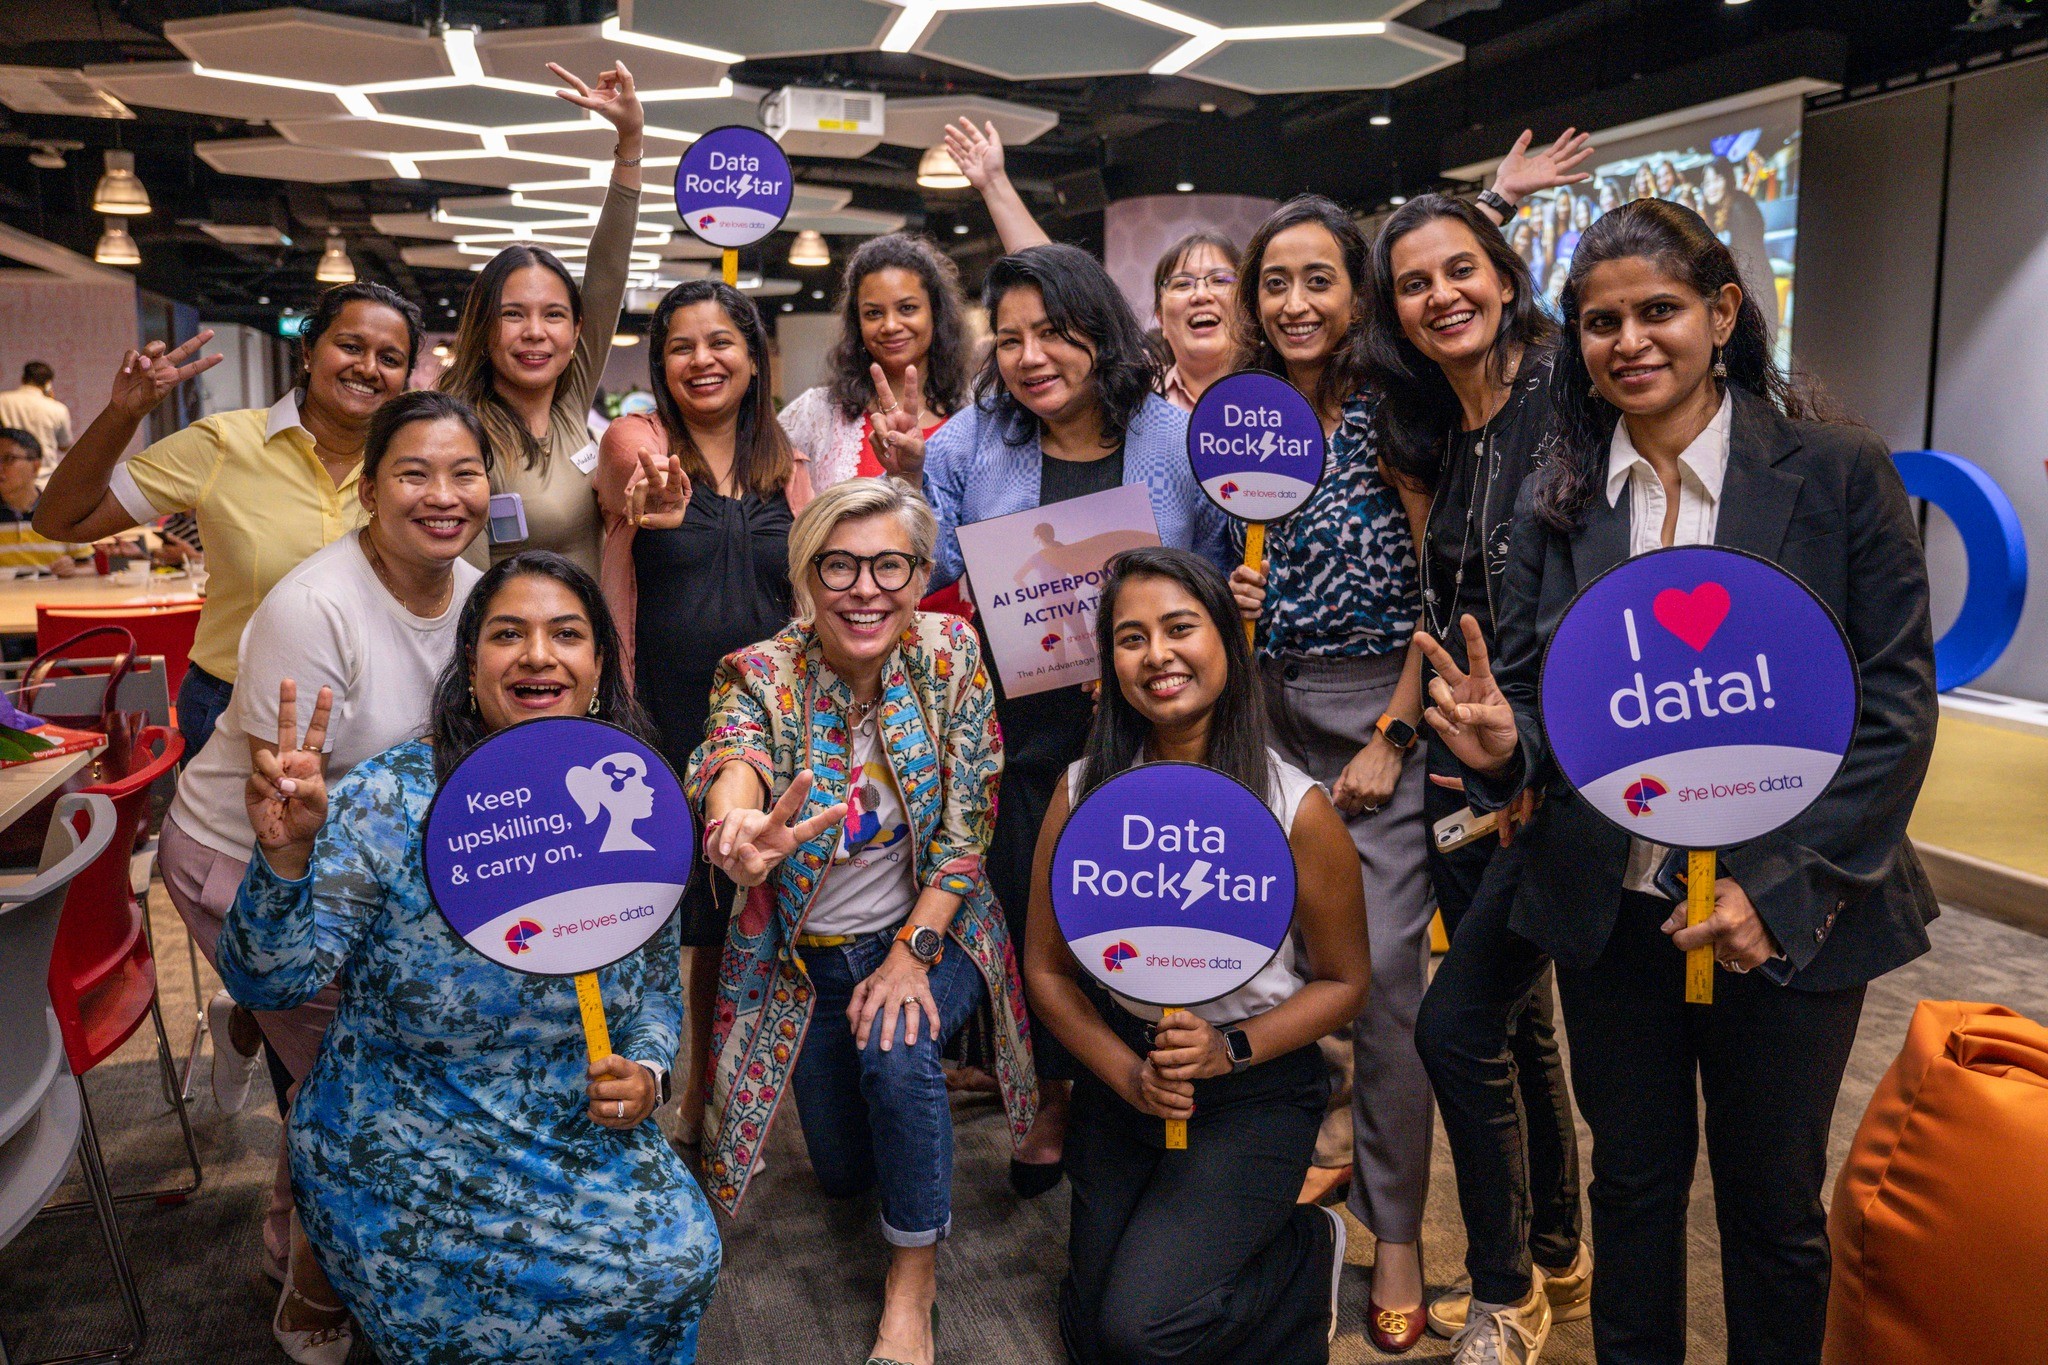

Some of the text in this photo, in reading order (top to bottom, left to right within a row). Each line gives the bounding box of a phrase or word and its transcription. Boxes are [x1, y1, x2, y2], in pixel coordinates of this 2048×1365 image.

[709, 151, 760, 172] Data
[731, 221, 749, 229] loves
[1224, 404, 1282, 428] Data
[1242, 489, 1297, 499] she loves data
[993, 592, 1011, 609] AI
[1623, 608, 1641, 662] I
[1017, 669, 1034, 679] The
[1036, 666, 1046, 676] AI
[1047, 657, 1095, 672] Advantage
[1609, 653, 1776, 729] data!
[466, 787, 532, 814] Keep
[1678, 774, 1804, 803] she loves data
[448, 812, 573, 854] upskilling,
[1123, 814, 1225, 854] Data
[451, 844, 583, 885] & carry on.
[551, 904, 655, 938] she loves data
[1145, 953, 1242, 970] she loves data
